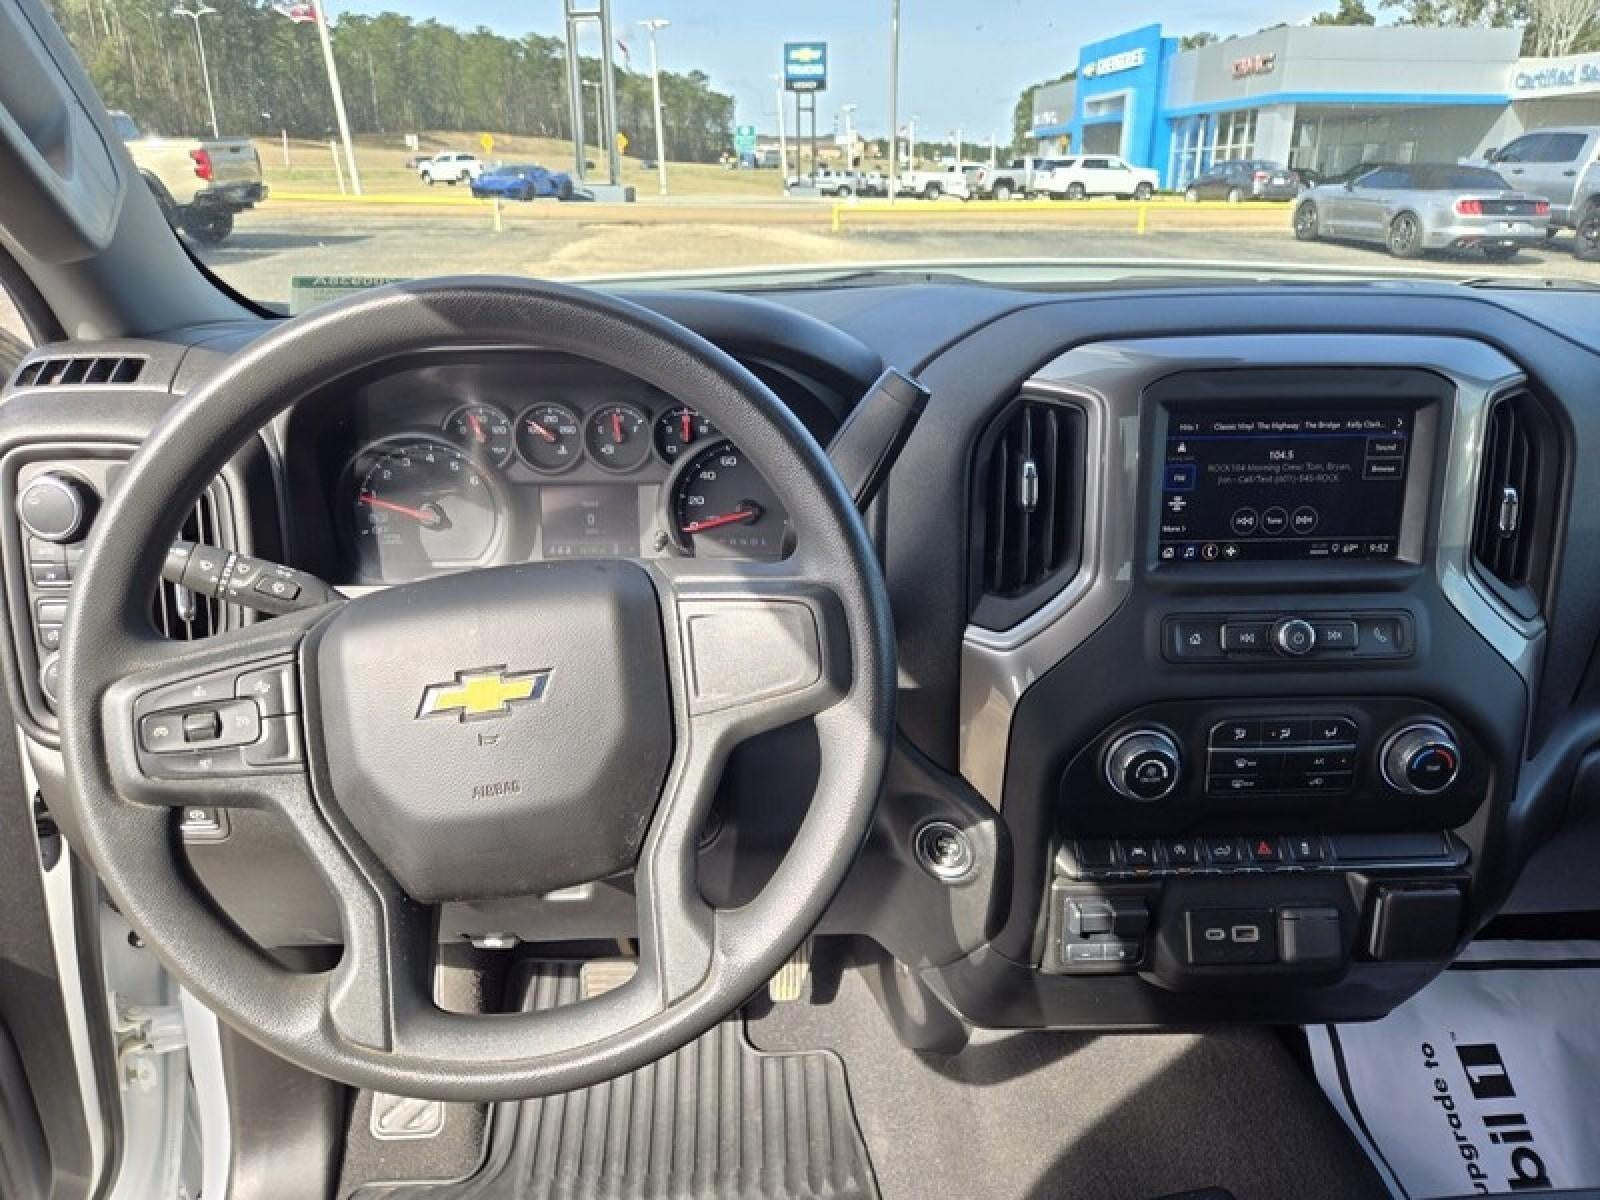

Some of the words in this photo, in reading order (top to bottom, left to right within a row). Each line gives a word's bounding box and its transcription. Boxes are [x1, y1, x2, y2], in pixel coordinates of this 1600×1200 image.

[1515, 67, 1576, 91] Certified
[1269, 449, 1295, 460] 104.5
[1421, 1041, 1440, 1069] to
